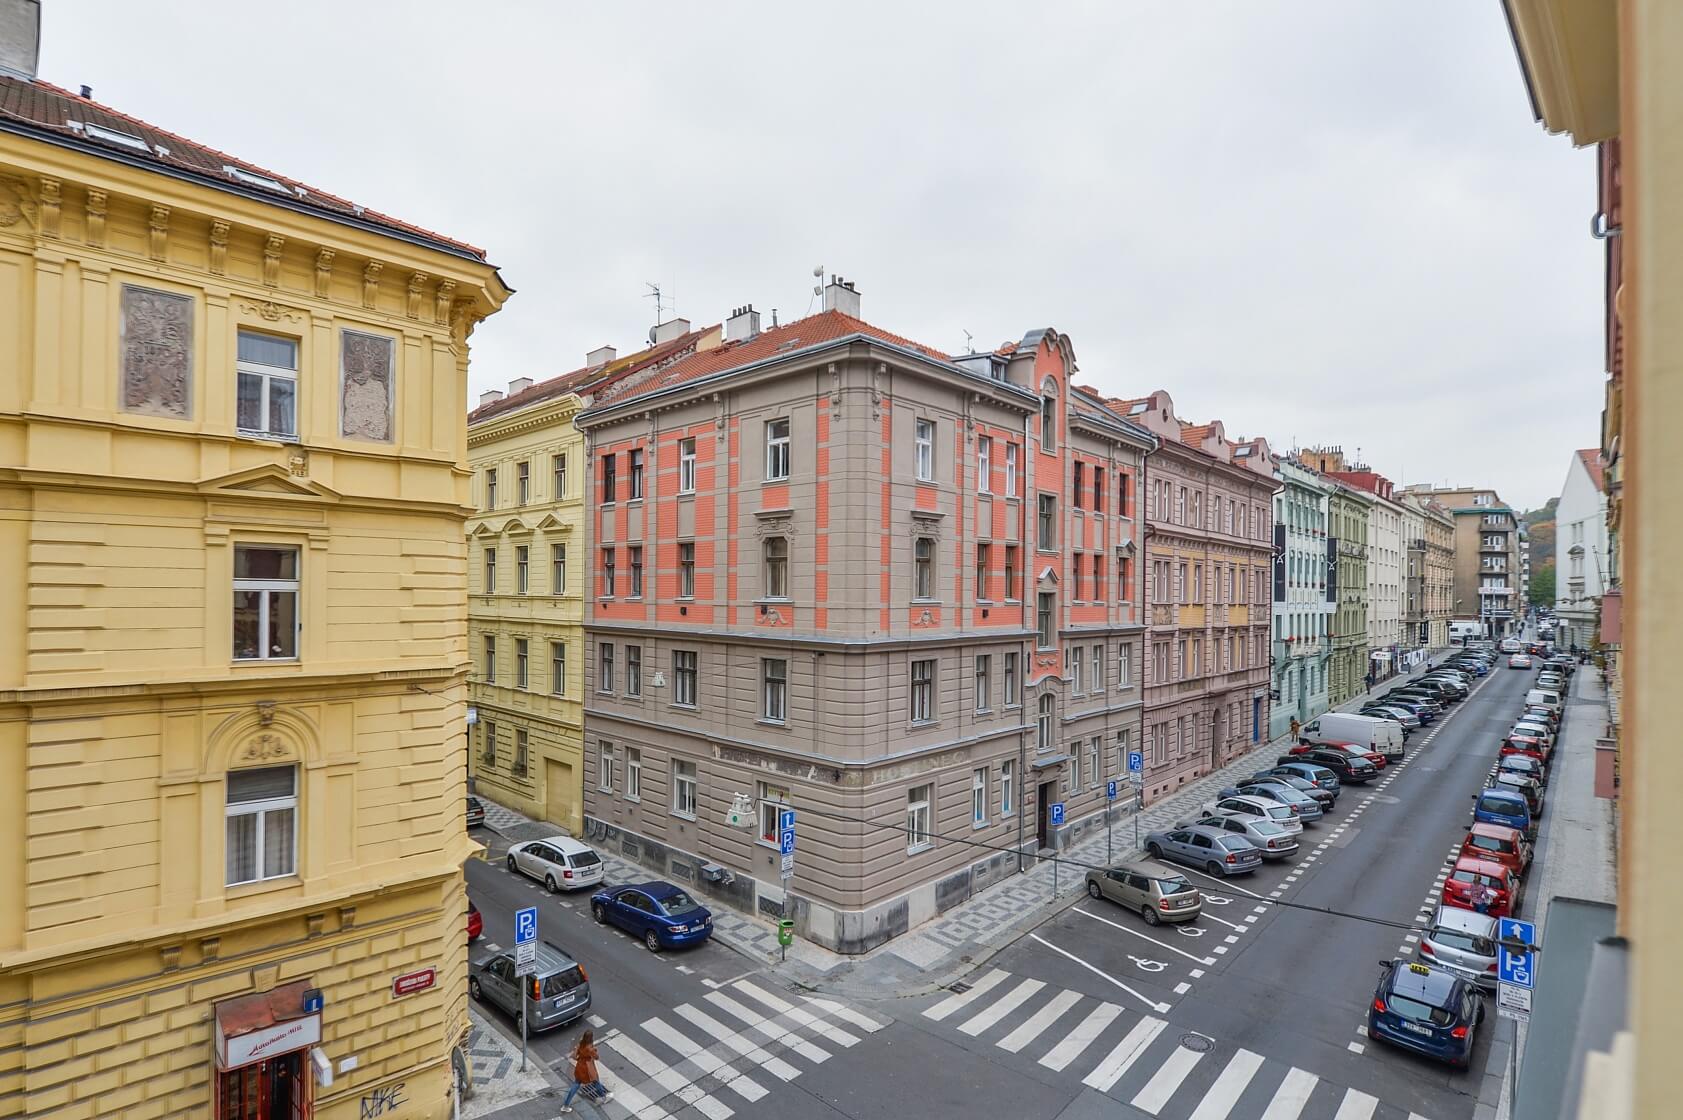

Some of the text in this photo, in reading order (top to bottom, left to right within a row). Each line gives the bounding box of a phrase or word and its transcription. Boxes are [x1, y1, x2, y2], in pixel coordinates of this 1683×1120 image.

[1131, 755, 1139, 765] P
[1053, 806, 1061, 818] P
[783, 833, 792, 848] P
[520, 913, 532, 933] P
